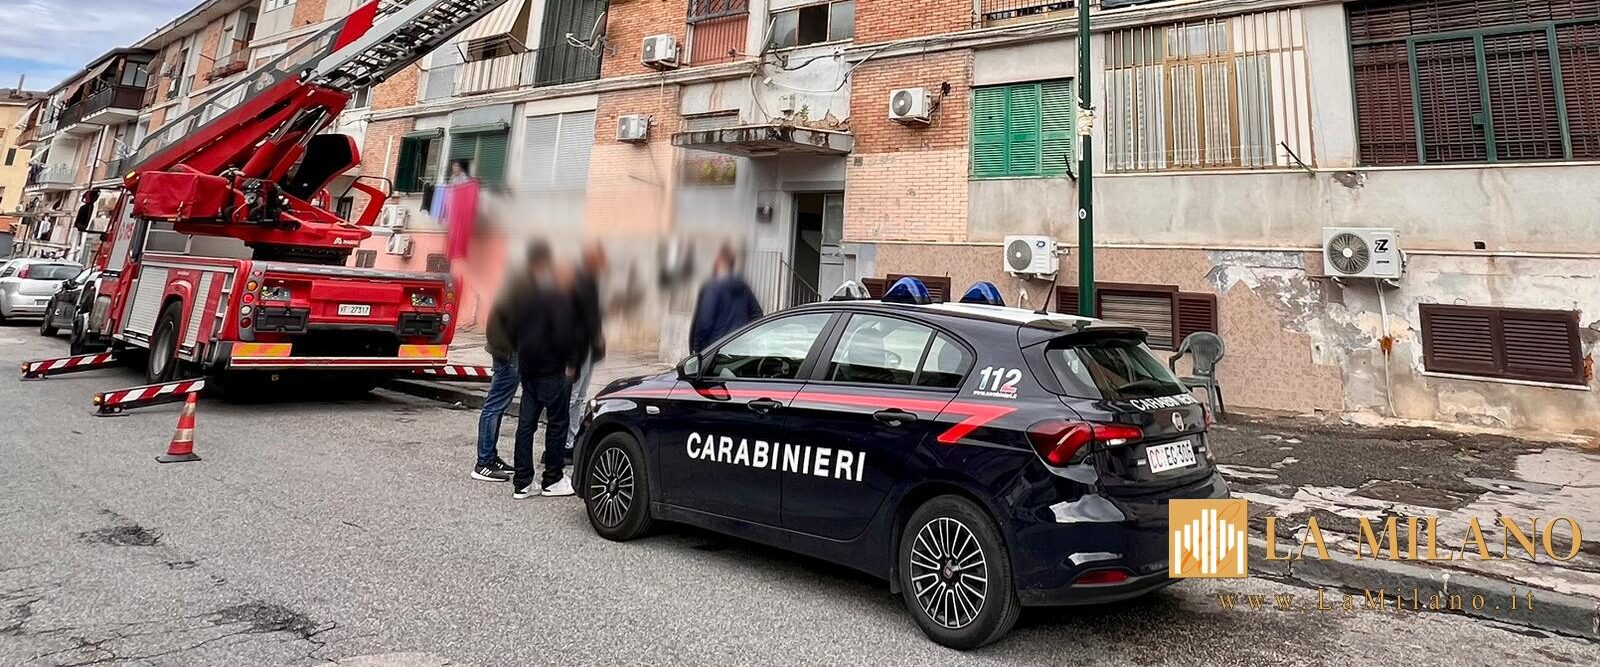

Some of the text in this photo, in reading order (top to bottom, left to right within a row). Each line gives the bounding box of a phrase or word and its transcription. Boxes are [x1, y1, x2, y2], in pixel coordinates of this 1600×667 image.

[978, 366, 1022, 392] 112
[686, 431, 867, 482] CARABINIERI
[1149, 448, 1163, 469] CC
